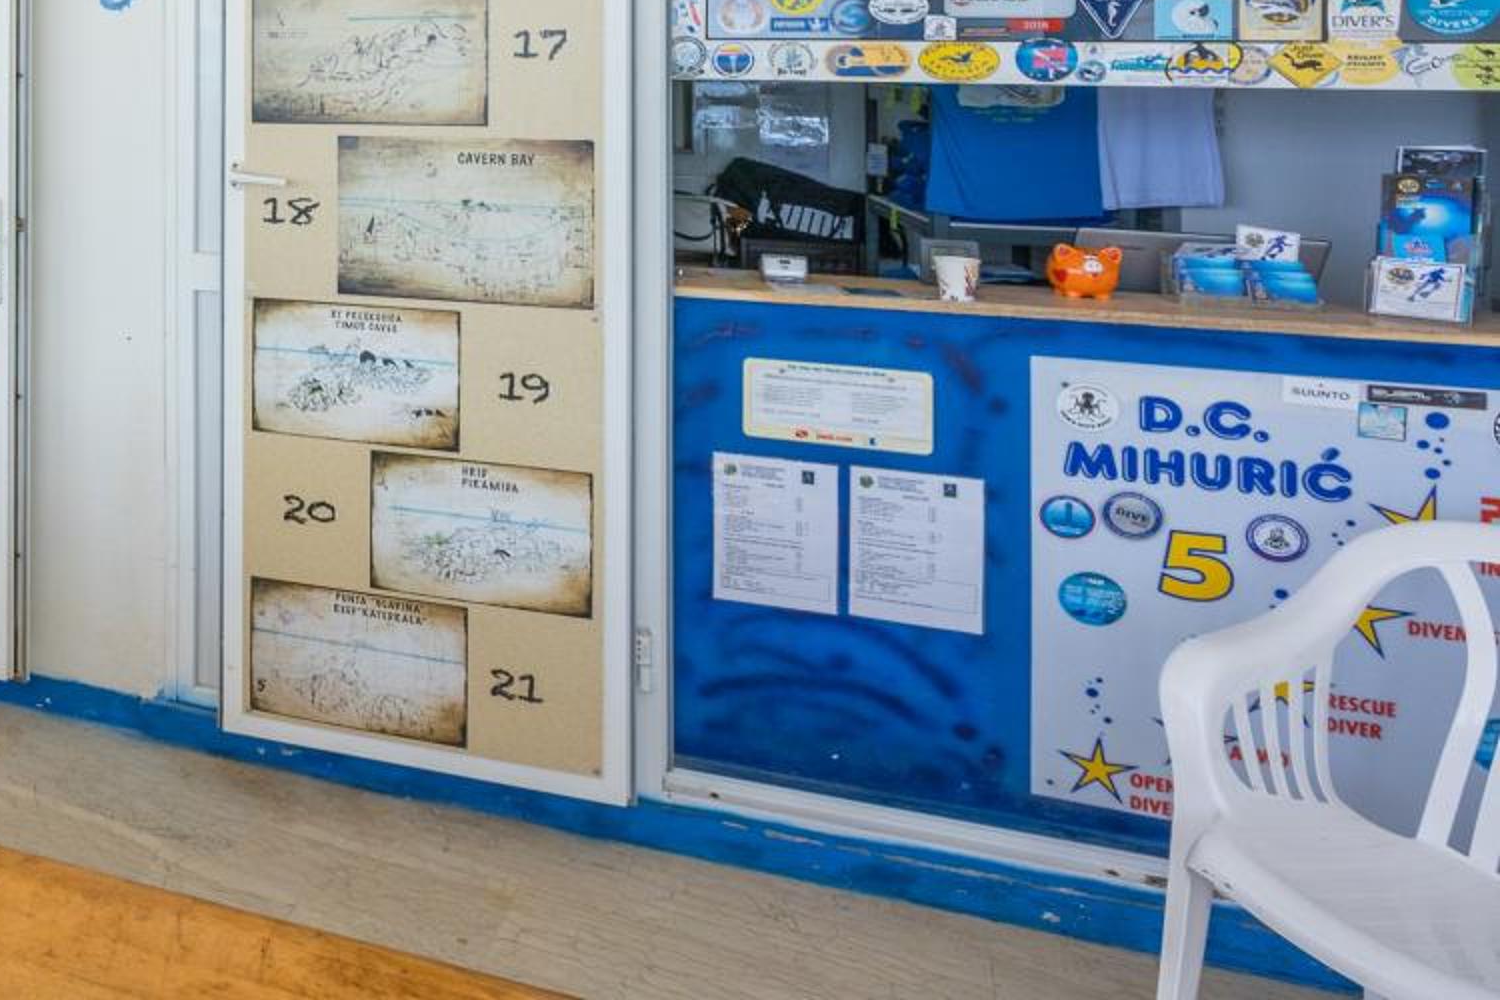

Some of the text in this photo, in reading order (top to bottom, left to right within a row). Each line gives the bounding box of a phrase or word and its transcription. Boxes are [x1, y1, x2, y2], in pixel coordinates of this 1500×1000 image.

[1331, 15, 1394, 28] DIVER'S
[512, 28, 568, 60] 17
[457, 151, 535, 166] CAVERN BAY
[263, 197, 320, 225] 18
[498, 371, 550, 404] 19
[1291, 386, 1350, 401] SUUNTO
[1139, 395, 1269, 443] D.C.
[1063, 440, 1353, 502] MIHURIĆ
[282, 494, 336, 524] 20
[1157, 528, 1235, 602] 5
[489, 668, 544, 703] 21
[1328, 693, 1397, 718] RESCUE
[1328, 716, 1382, 740] DIVER
